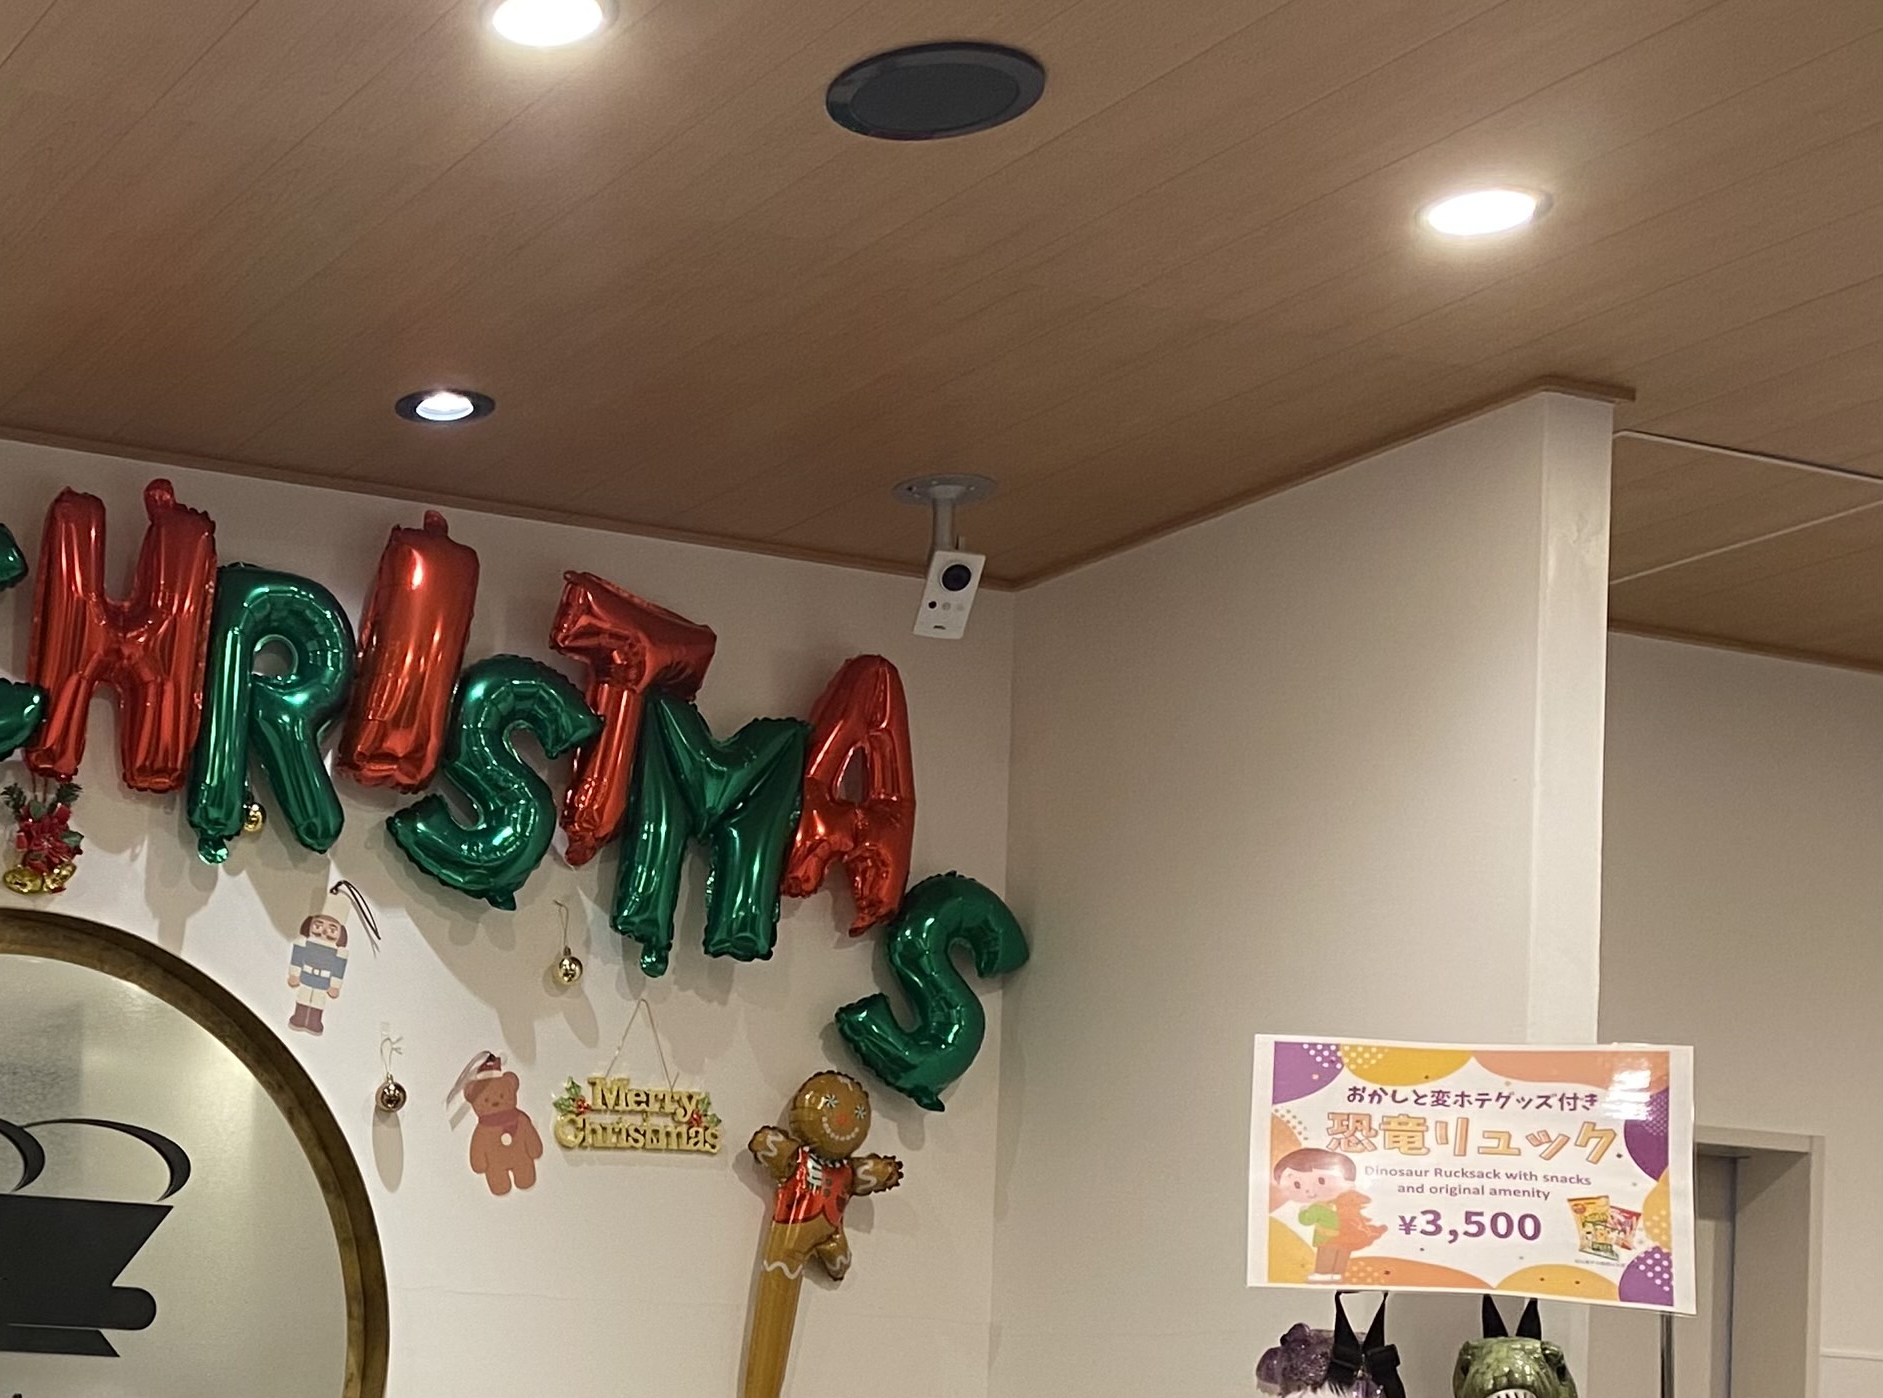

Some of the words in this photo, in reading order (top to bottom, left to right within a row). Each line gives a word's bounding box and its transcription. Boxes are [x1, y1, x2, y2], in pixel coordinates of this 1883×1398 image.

[588, 1077, 703, 1121] Merry
[554, 1115, 721, 1154] Christmas
[1326, 1111, 1618, 1165] 恐竜リュック
[1365, 1165, 1430, 1178] Dinosaur
[1434, 1167, 1501, 1180] Rucksack
[1506, 1169, 1538, 1182] with
[1543, 1173, 1591, 1185] snacks
[1398, 1183, 1424, 1195] and
[1430, 1183, 1484, 1199] original
[1489, 1186, 1551, 1201] amenity
[1398, 1209, 1541, 1244] ¥3,500
